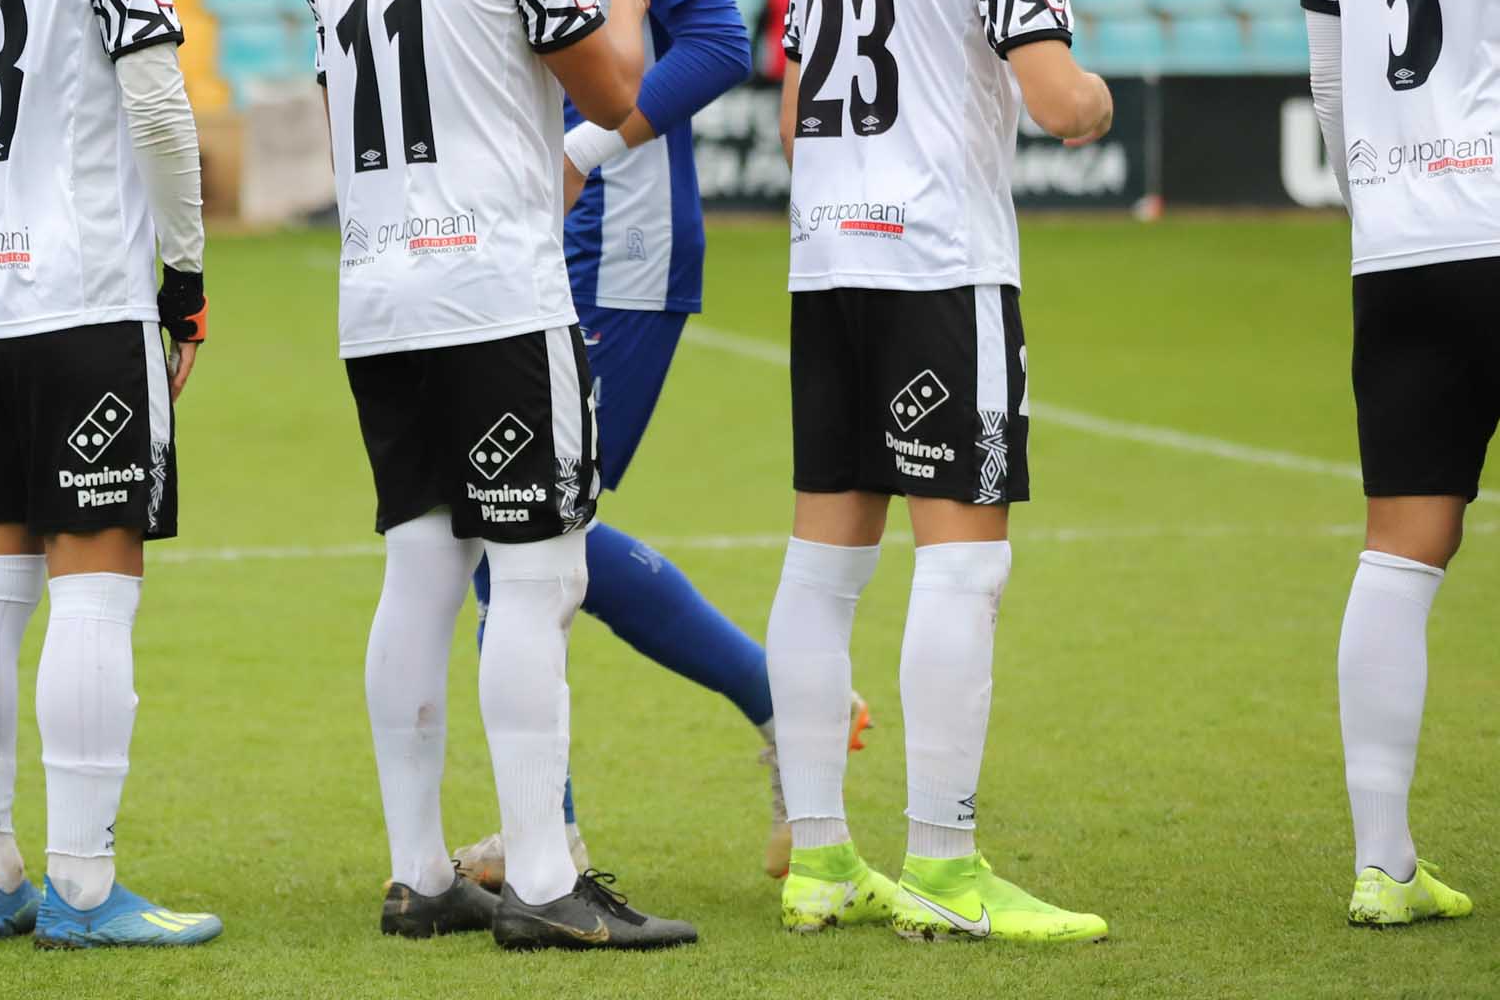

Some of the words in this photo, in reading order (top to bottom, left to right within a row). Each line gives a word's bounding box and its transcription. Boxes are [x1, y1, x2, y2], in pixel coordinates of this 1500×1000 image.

[885, 431, 956, 462] Domino's
[59, 463, 145, 488] Domino's
[896, 454, 935, 479] Pizza
[77, 489, 128, 507] Pizza
[466, 483, 546, 502] Domino's
[481, 504, 529, 522] Pizza
